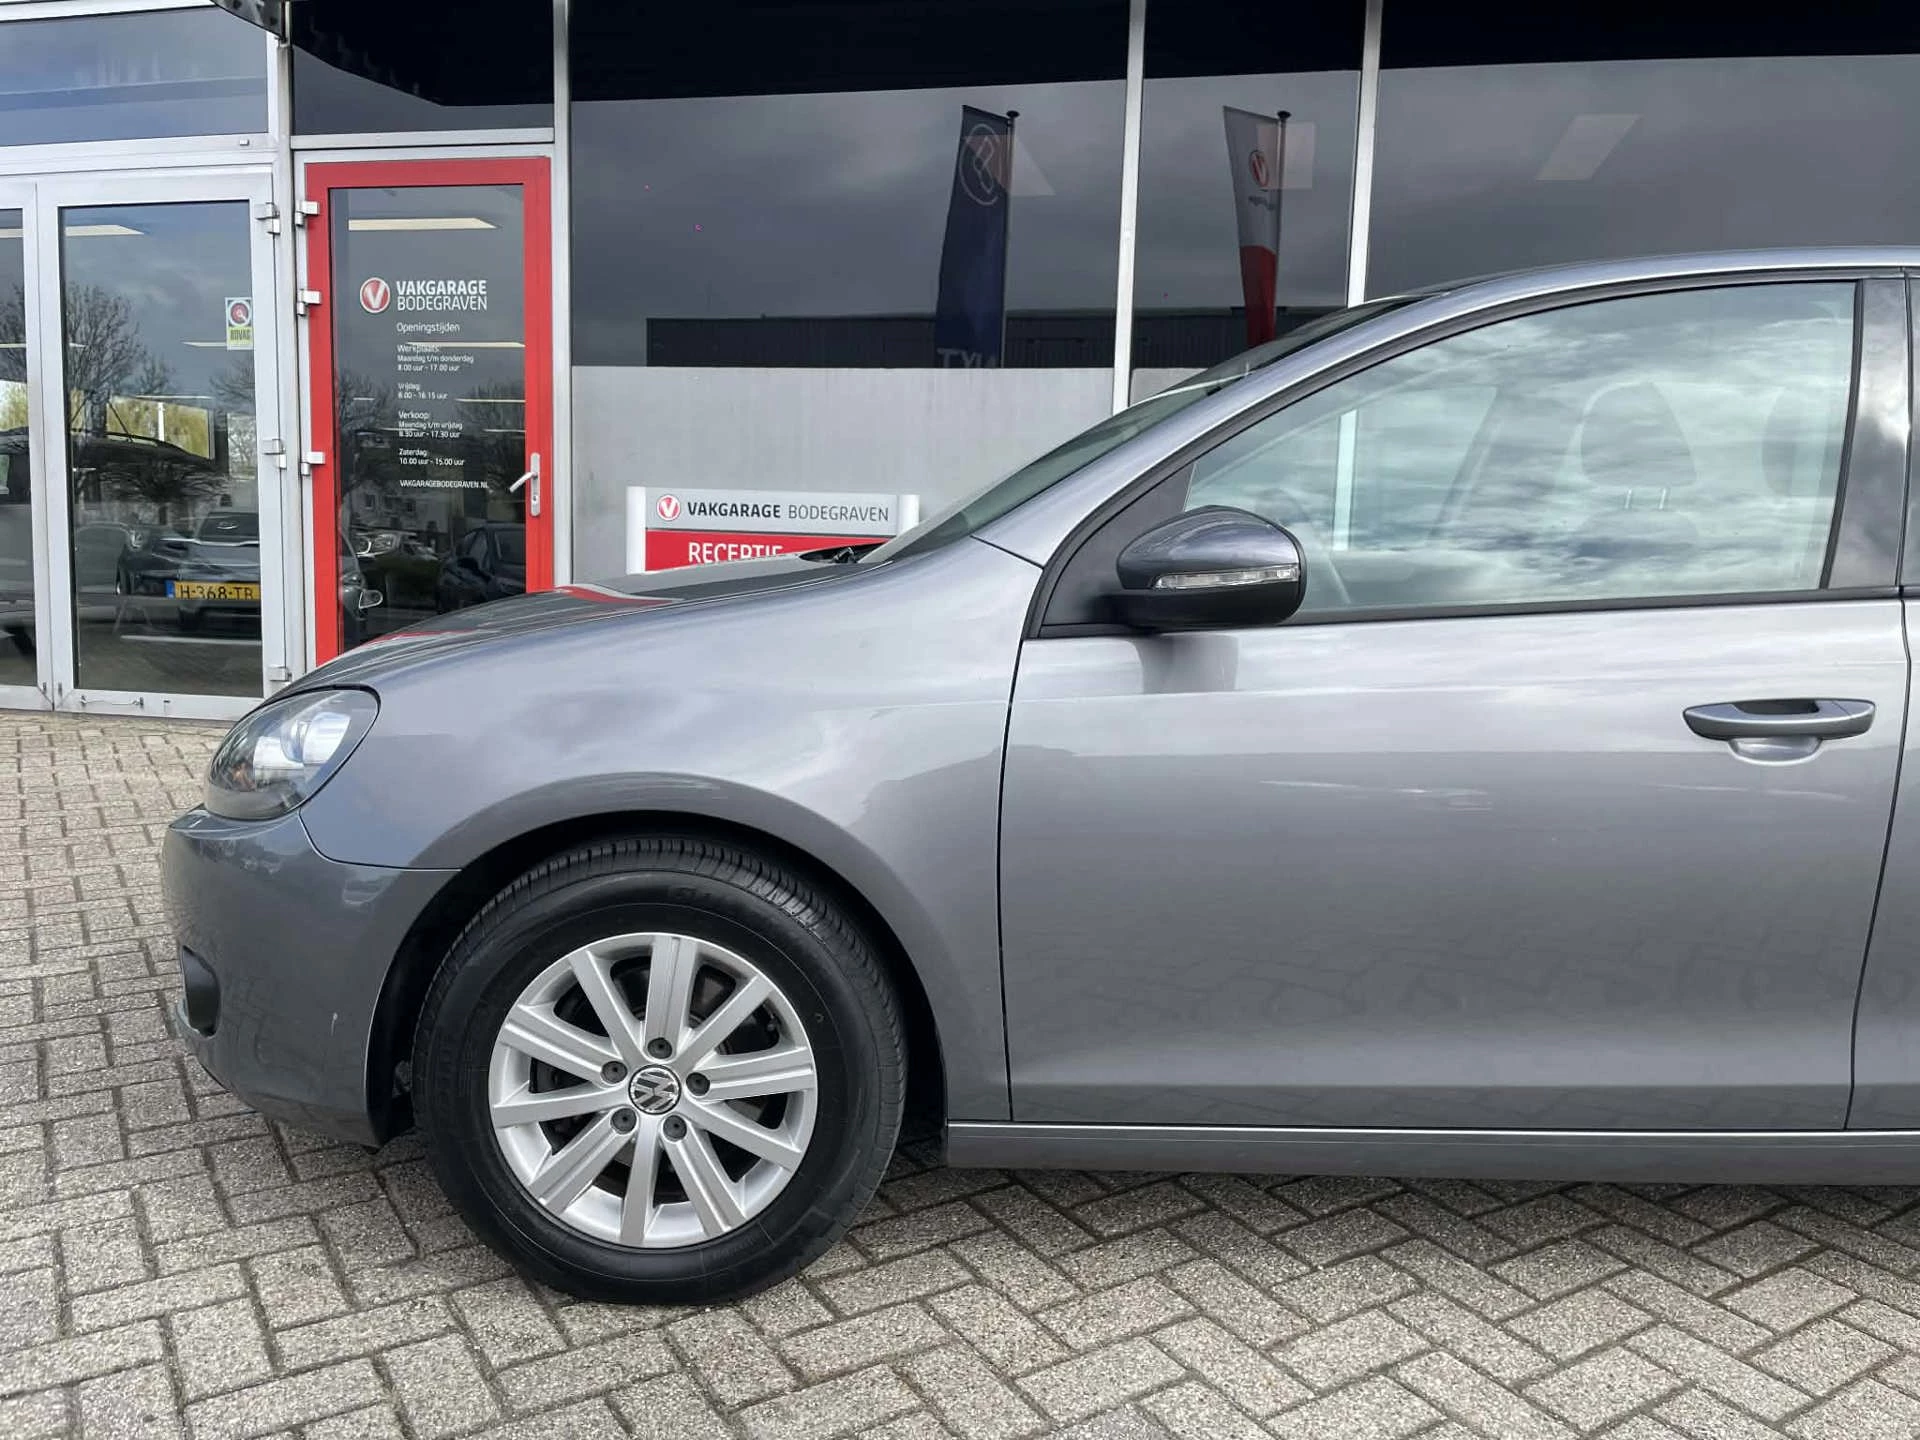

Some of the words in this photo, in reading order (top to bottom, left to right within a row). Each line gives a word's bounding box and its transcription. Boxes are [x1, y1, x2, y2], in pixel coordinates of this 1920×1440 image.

[396, 279, 487, 295] VAKGARAGE
[397, 295, 488, 311] BODEGRAVEN
[396, 321, 460, 334] Openingstijden
[397, 354, 426, 364] Maandag
[430, 364, 448, 372] 17.00
[398, 421, 427, 430] Maandag
[431, 430, 449, 438] 17.30
[435, 458, 453, 466] 15.00
[400, 479, 489, 489] VAKGARAGEBODEGRAVEN.NL
[687, 501, 781, 519] VAKGARAGE
[788, 504, 889, 523] BODEGRAVEN
